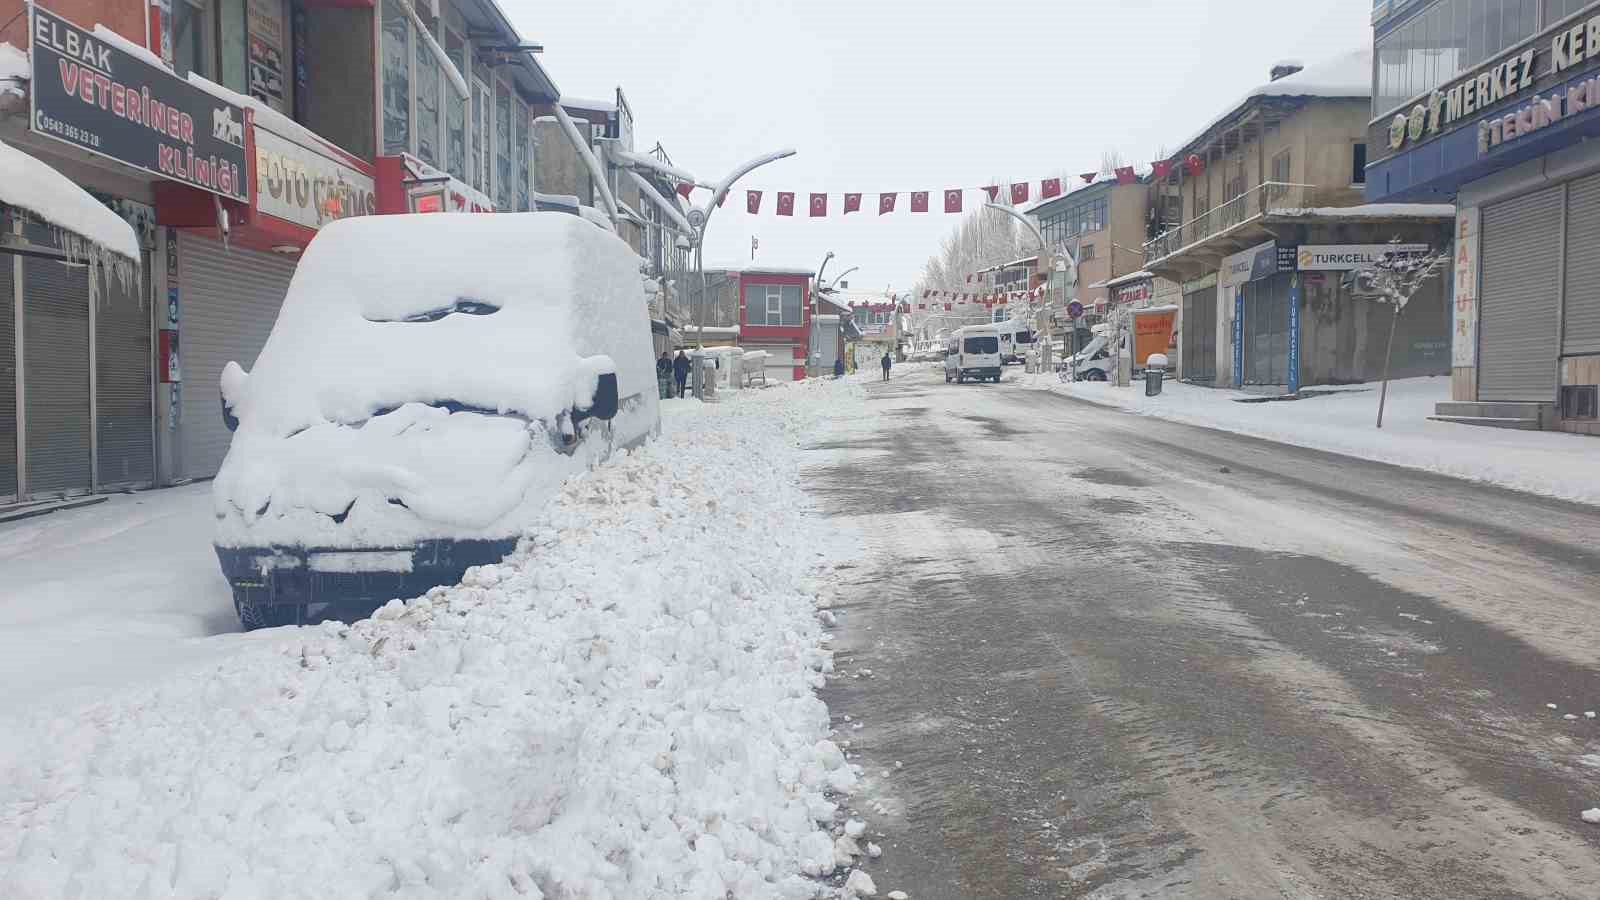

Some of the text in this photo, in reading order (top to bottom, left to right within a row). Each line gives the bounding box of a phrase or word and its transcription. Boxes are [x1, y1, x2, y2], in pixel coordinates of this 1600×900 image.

[35, 15, 112, 73] ELBAK
[58, 58, 194, 145] VETERİNER
[1446, 48, 1537, 123] MERKEZ
[43, 116, 63, 134] 0543
[158, 143, 239, 197] KLİNİĞİ
[256, 146, 309, 209] FOTO
[1315, 253, 1374, 264] TURKCELL
